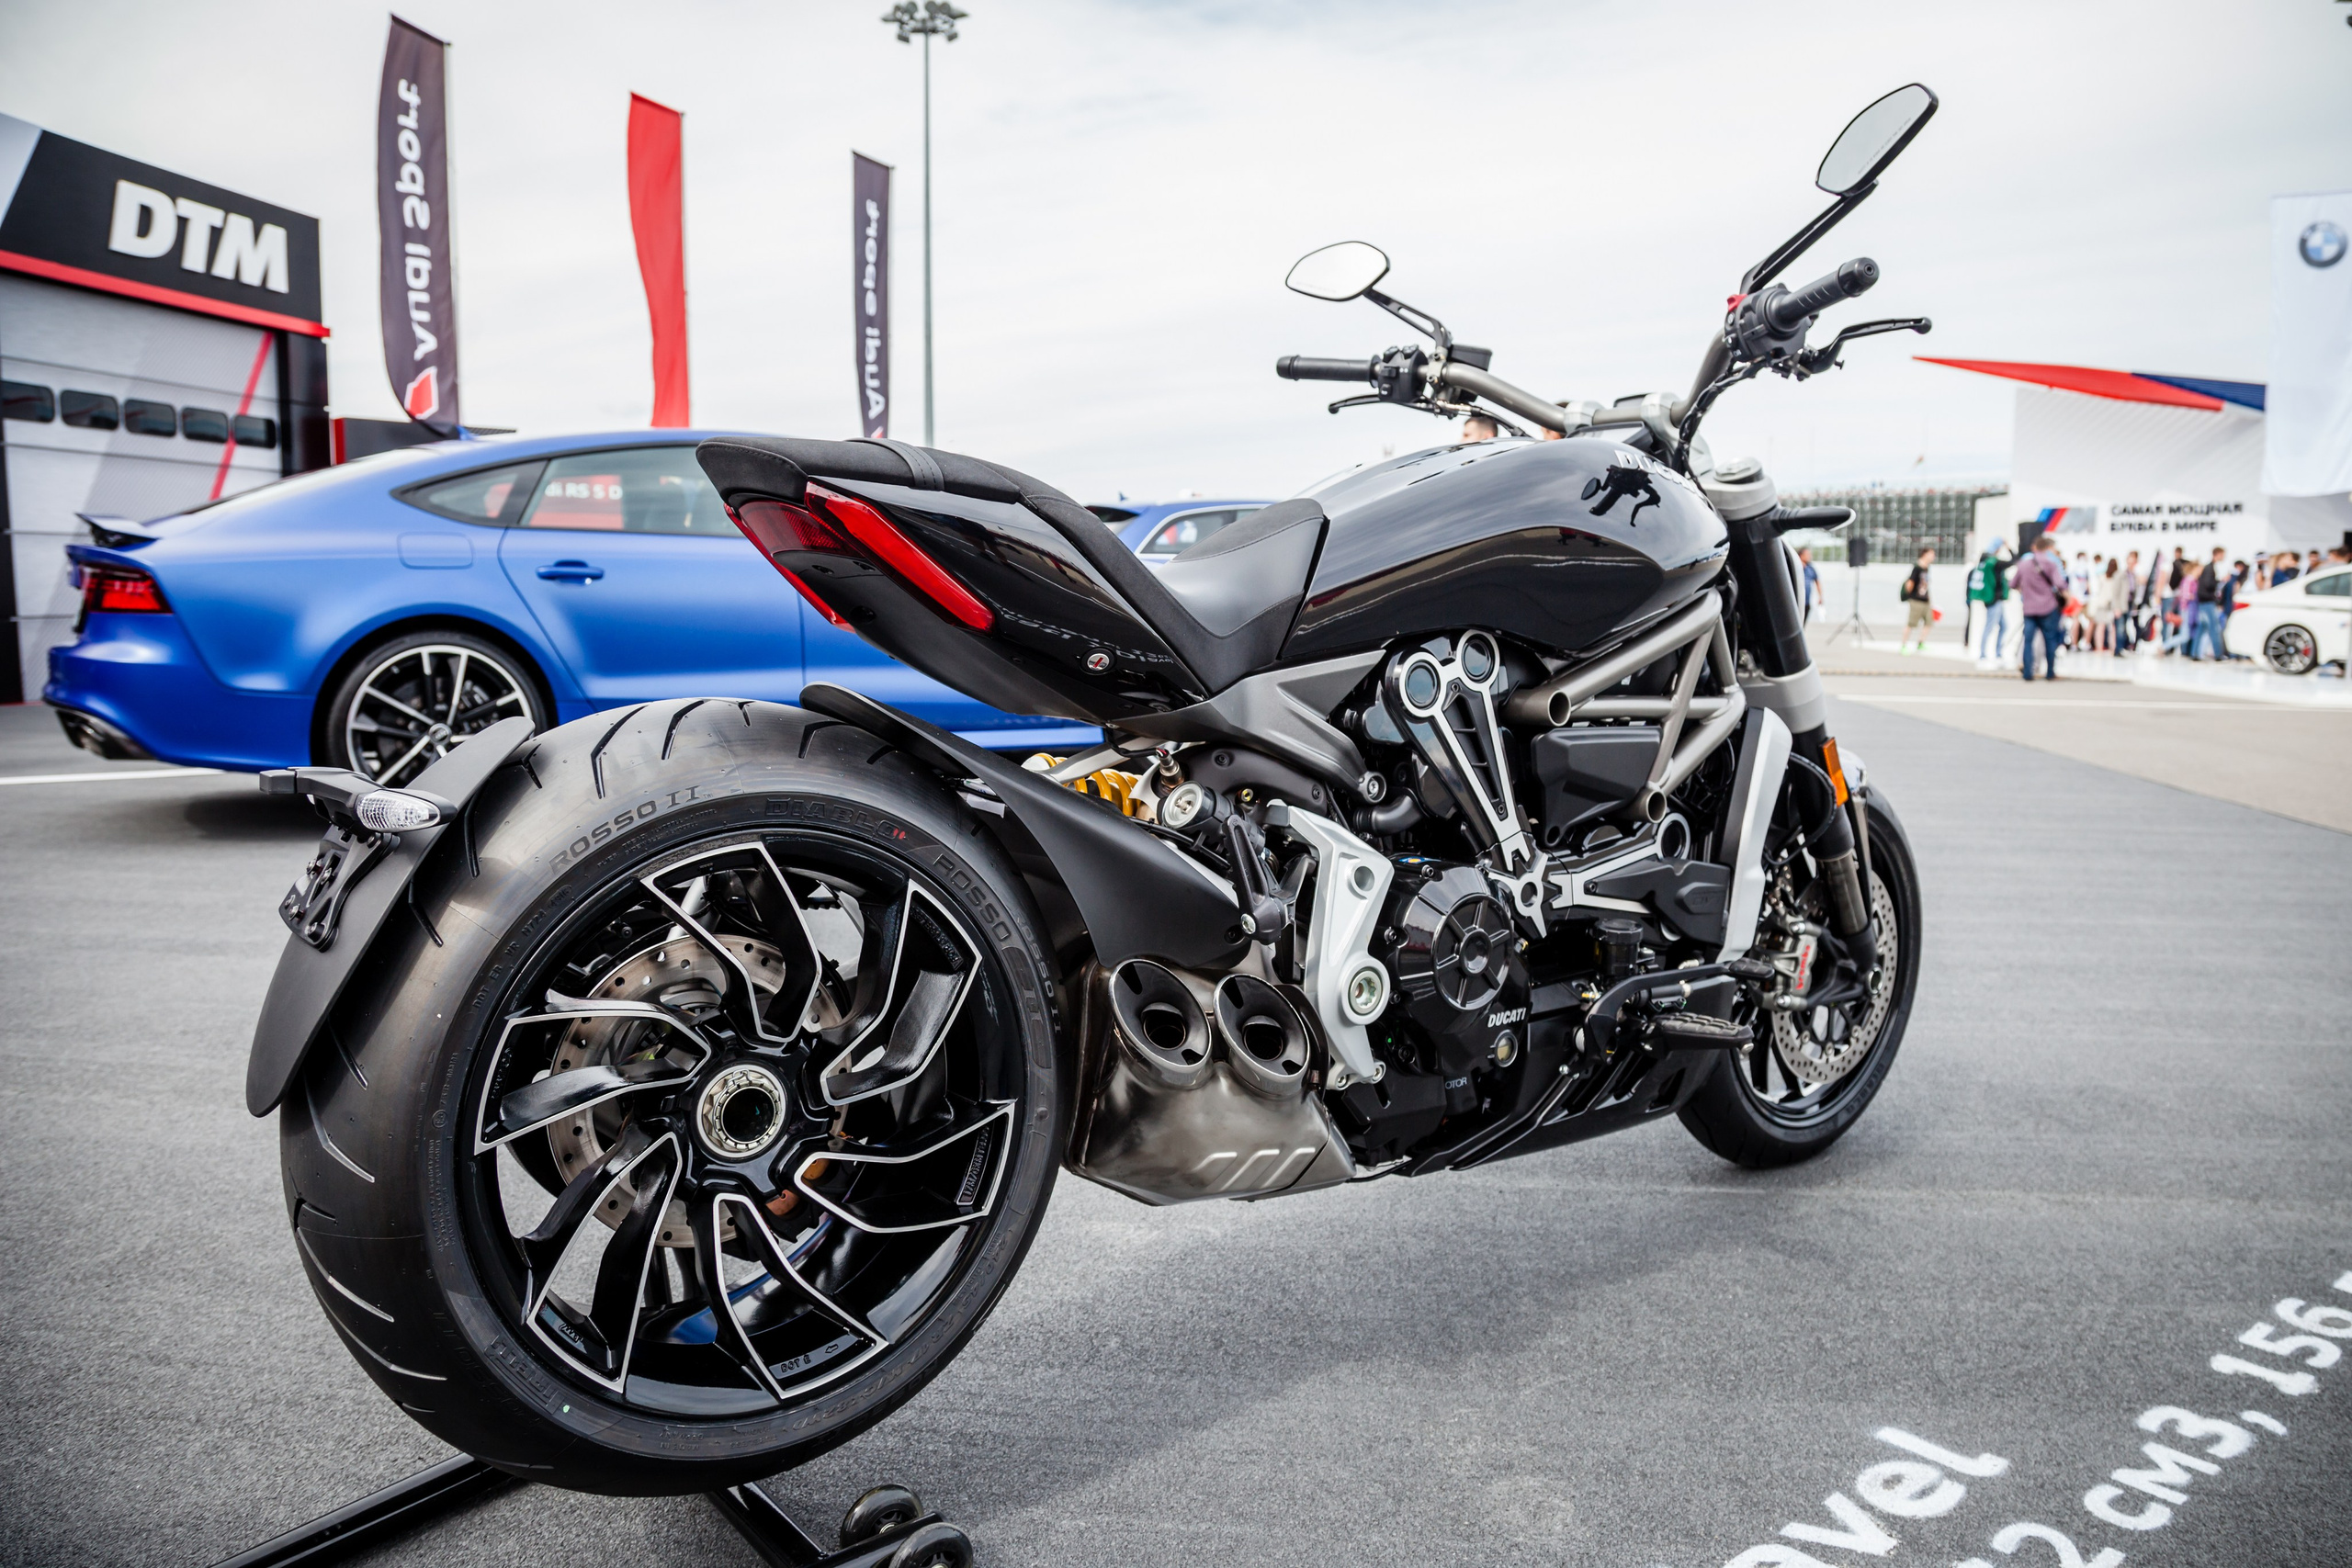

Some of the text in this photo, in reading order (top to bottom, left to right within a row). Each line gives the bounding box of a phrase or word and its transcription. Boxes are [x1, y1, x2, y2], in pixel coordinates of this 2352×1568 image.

[108, 179, 289, 294] DTM
[545, 797, 659, 875] ROSSO
[663, 783, 700, 808] II
[764, 796, 902, 843] DIABLO
[930, 851, 1014, 944] ROSSO
[1010, 908, 1057, 998] ROSSO
[1487, 1008, 1527, 1028] DUCATI
[781, 1358, 800, 1373] DOT
